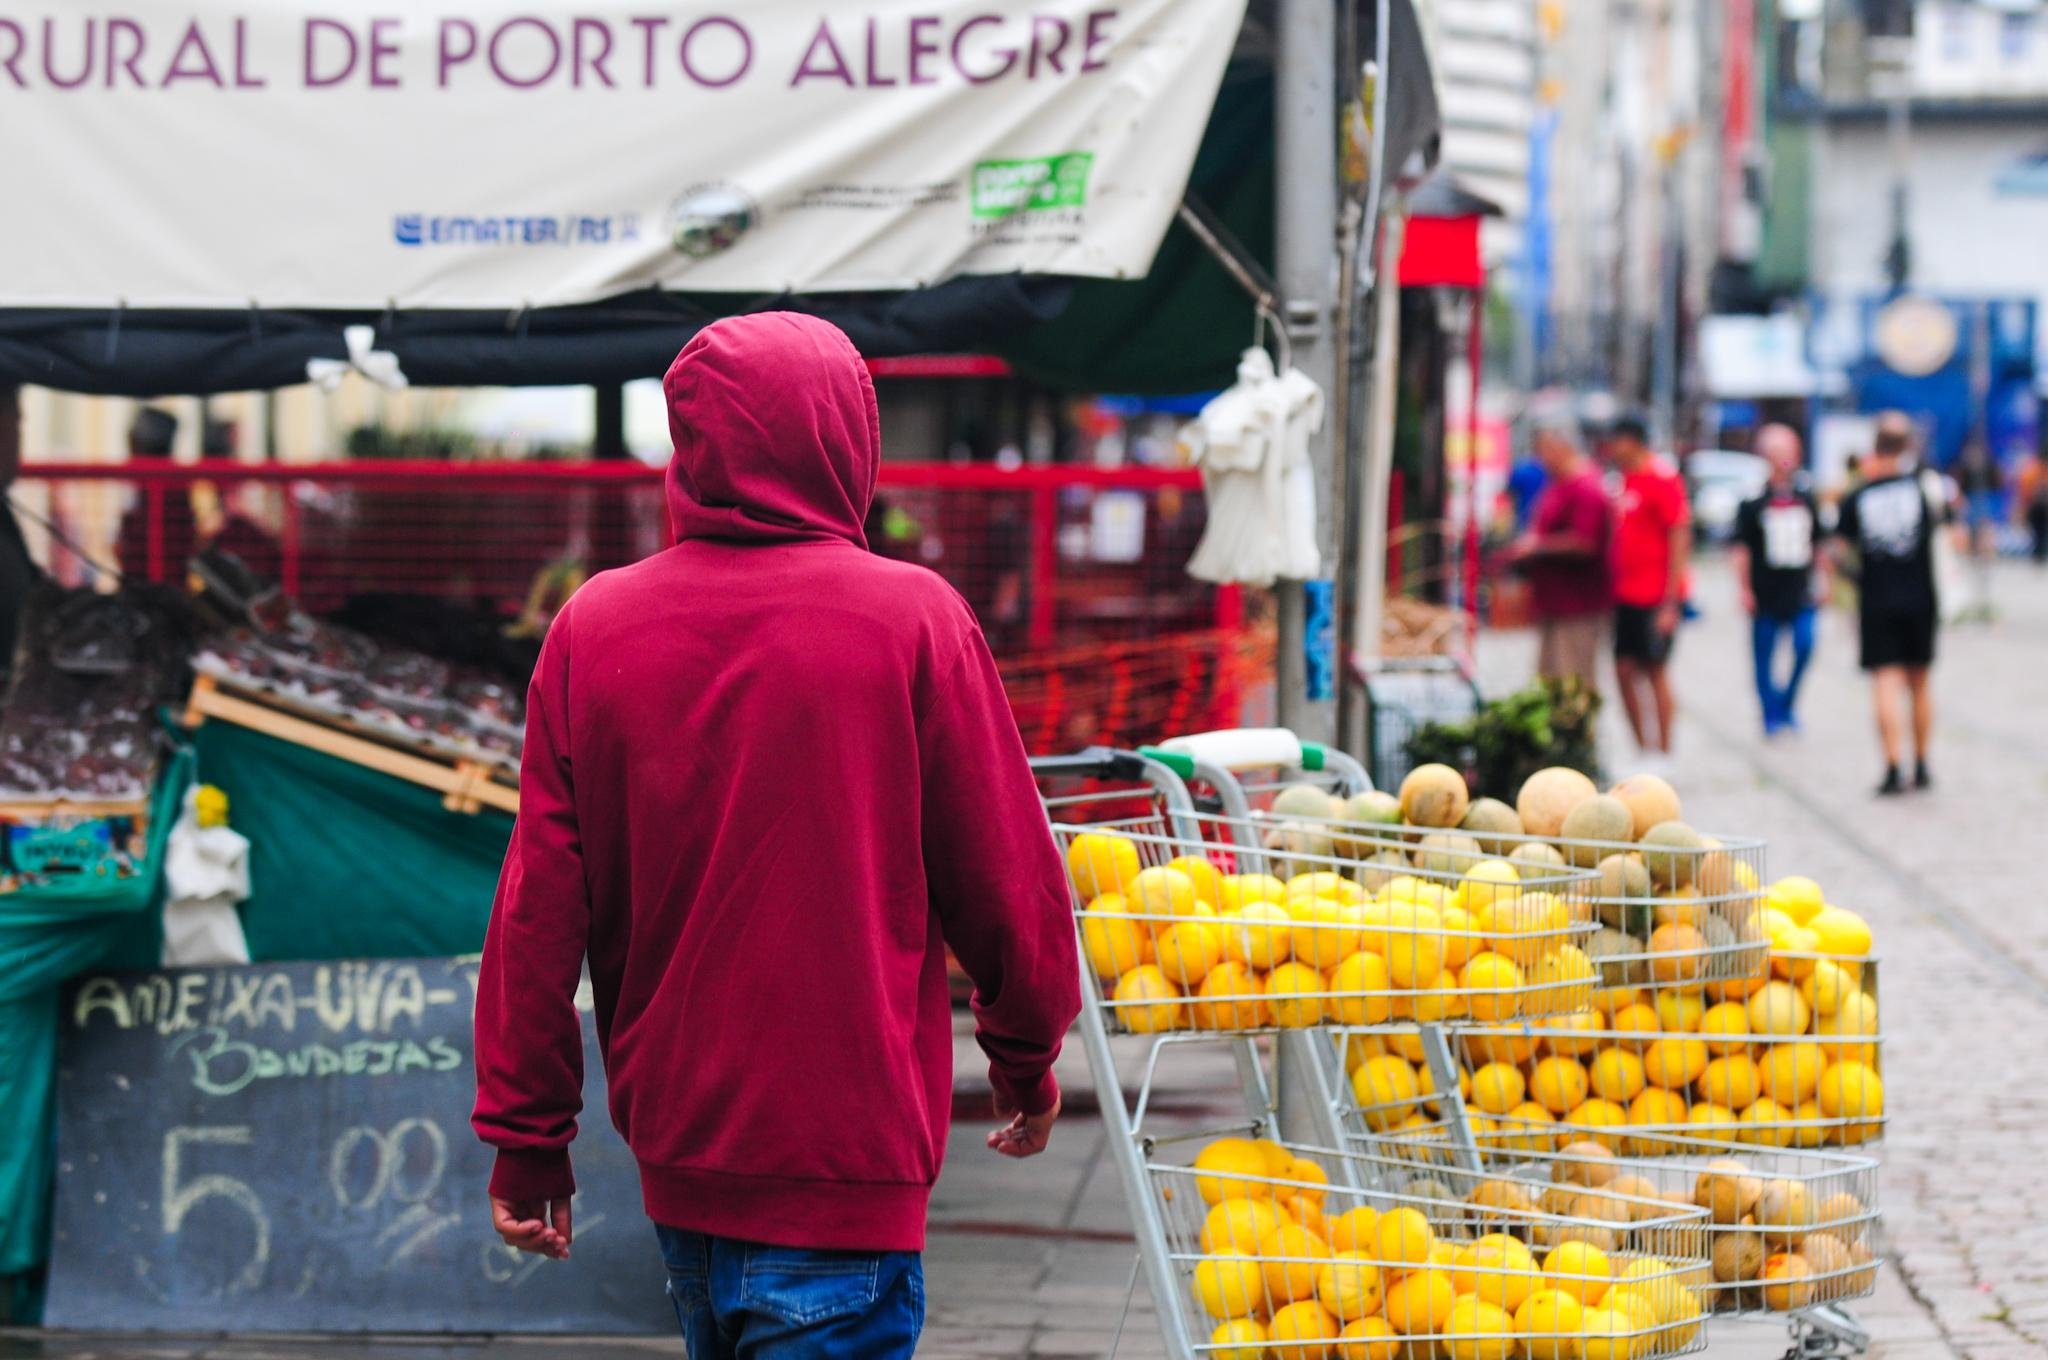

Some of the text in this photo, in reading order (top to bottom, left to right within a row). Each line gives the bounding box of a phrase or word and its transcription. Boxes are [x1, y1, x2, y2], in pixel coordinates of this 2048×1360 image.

[0, 9, 1118, 90] RURAL DE PORTO ALEGRE
